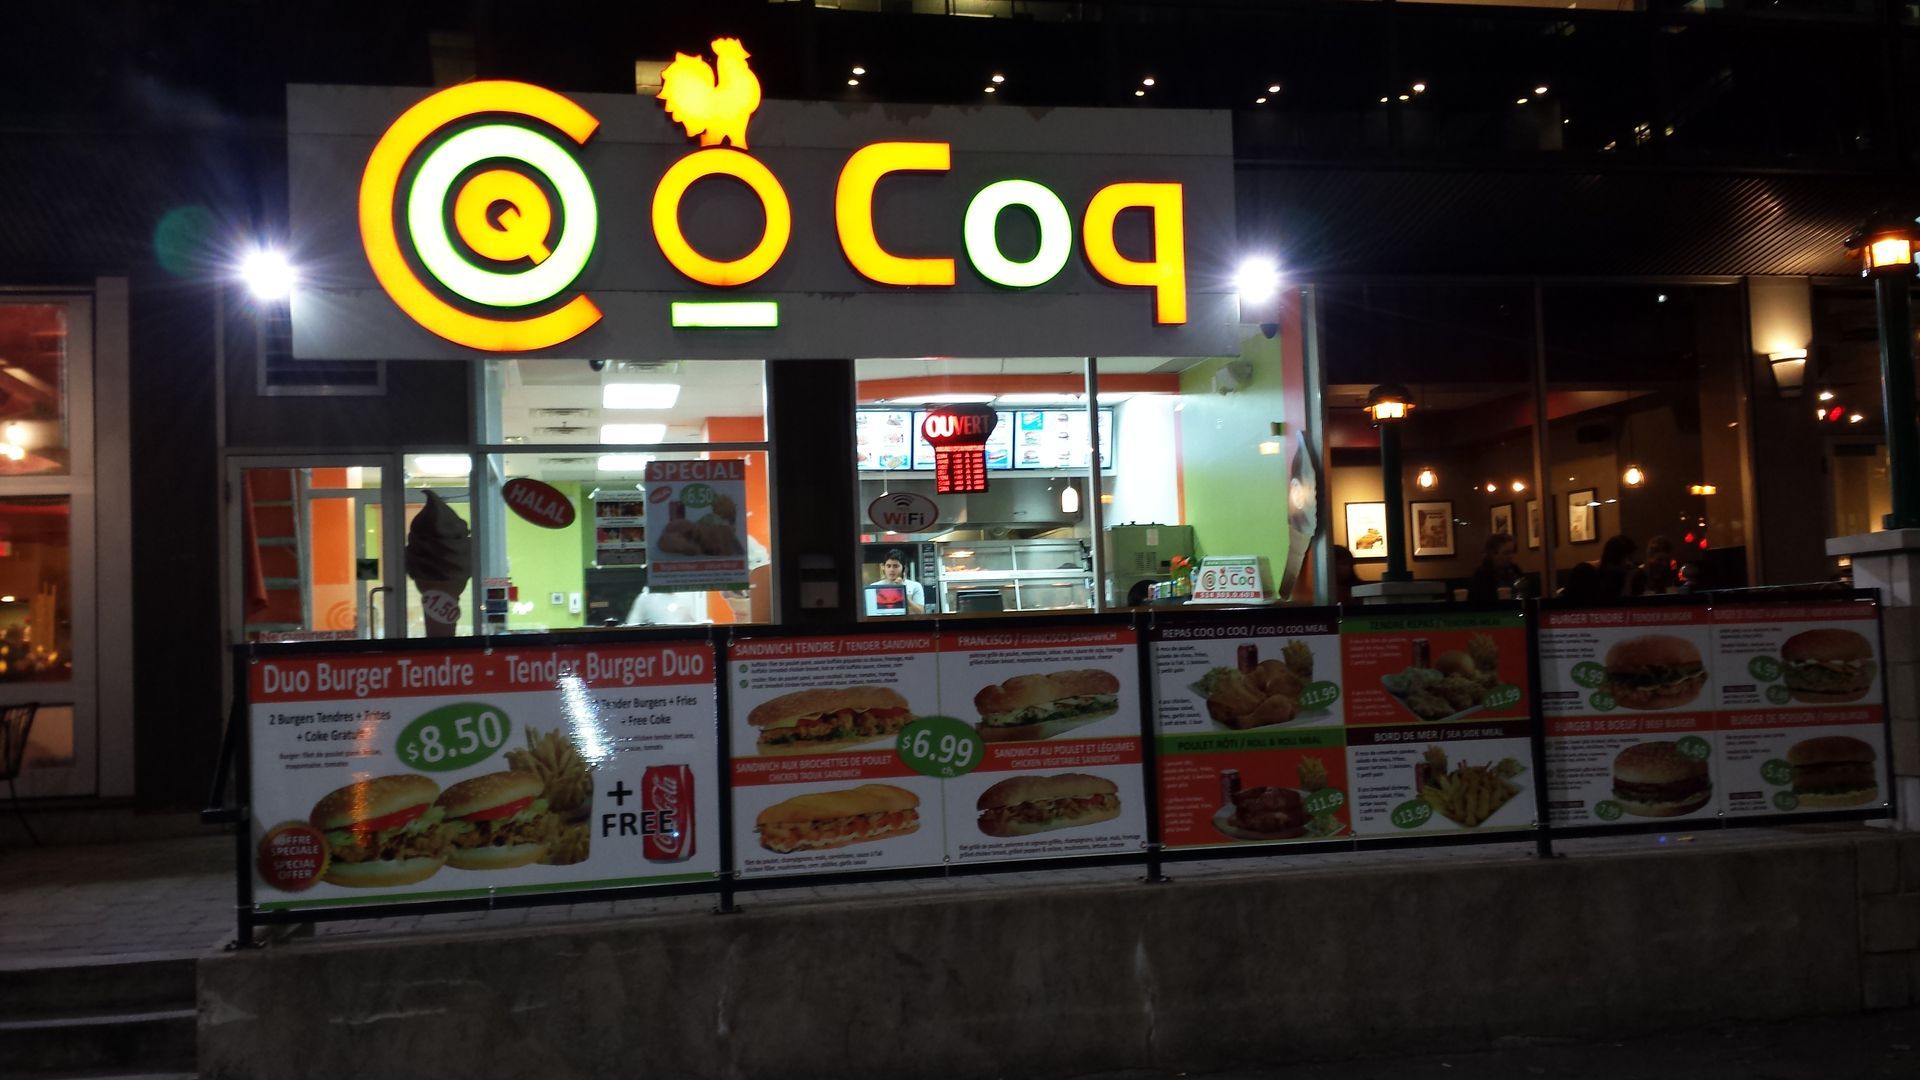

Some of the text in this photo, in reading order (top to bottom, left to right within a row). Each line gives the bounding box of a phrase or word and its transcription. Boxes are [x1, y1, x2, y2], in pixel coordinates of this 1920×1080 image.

[835, 141, 1188, 325] Coq
[925, 415, 990, 438] OUVERT
[652, 462, 740, 480] SPECIAL
[509, 483, 566, 524] HALAL
[883, 511, 925, 525] WiFi
[1549, 614, 1589, 624] BURGER
[1590, 613, 1624, 623] TENDRE
[1162, 628, 1191, 638] REPAS
[1193, 627, 1215, 637] COQ
[1227, 626, 1248, 636] COQ
[1257, 626, 1275, 635] COQ
[1285, 625, 1304, 634] COQ
[1305, 624, 1328, 633] MEAL
[958, 635, 1012, 646] FRANCISCO
[1070, 631, 1118, 642] SANDWICH
[736, 643, 792, 656] SANDWICH
[795, 641, 835, 654] TENDRE
[846, 641, 879, 651] TENDER
[882, 639, 930, 650] SANDWICH
[264, 664, 310, 693] Duo
[317, 662, 391, 697] Burger
[398, 656, 474, 688] Tendre
[506, 652, 580, 684] Tender
[587, 652, 656, 685] Burger
[662, 649, 704, 676] Duo
[633, 697, 667, 710] Burgers
[676, 696, 697, 706] Fries
[269, 714, 276, 725] 2
[277, 713, 315, 726] Burgers
[316, 711, 354, 723] Tendres
[628, 715, 647, 726] Free
[649, 714, 671, 725] Coke
[304, 731, 329, 742] Coke
[406, 711, 502, 763] $8.50
[1374, 732, 1400, 742] BORD
[1402, 732, 1415, 741] DE
[1417, 731, 1438, 740] MER
[1447, 730, 1462, 739] SEA
[1482, 728, 1504, 737] MEAL
[902, 729, 973, 767] $6.99
[994, 747, 1039, 758] SANDWICH
[1041, 746, 1053, 756] AU
[1054, 745, 1084, 755] POULET
[1086, 744, 1095, 754] ET
[1177, 740, 1213, 751] POULET
[736, 755, 892, 773] SANDWICH AUX BROCHETTES DE POULET
[769, 772, 798, 782] CHICKEN
[824, 769, 861, 779] SANDWICH
[1306, 792, 1344, 812] $11.99
[602, 810, 674, 838] FREE
[273, 835, 312, 845] OFFRE
[273, 860, 315, 870] SPECIAL
[278, 870, 312, 880] OFFER
